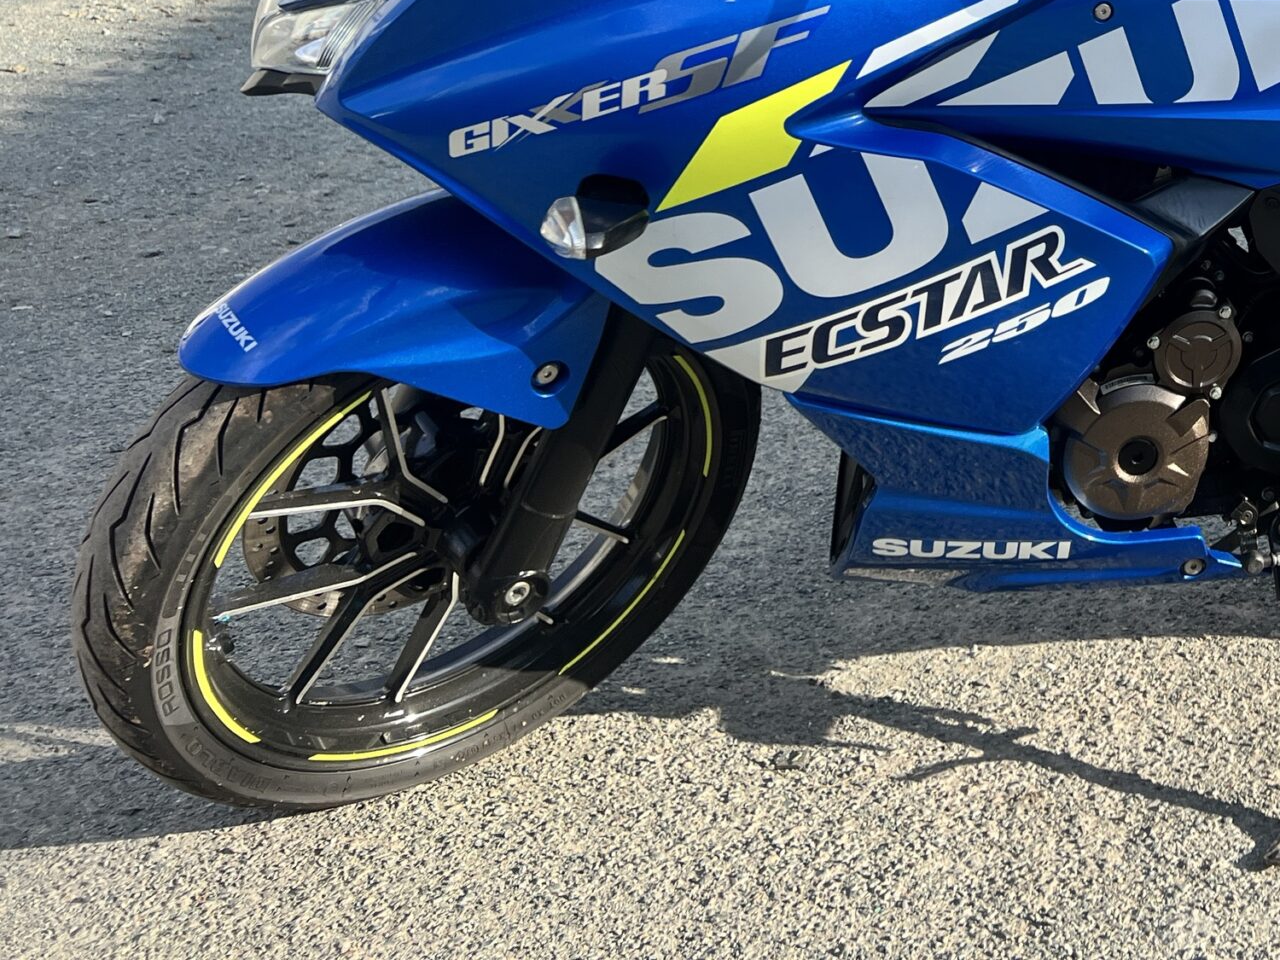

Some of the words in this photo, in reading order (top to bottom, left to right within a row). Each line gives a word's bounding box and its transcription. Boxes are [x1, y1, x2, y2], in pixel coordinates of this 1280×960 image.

[638, 4, 831, 114] SF
[215, 302, 258, 353] SUZUKI
[761, 225, 1096, 379] ECSTAR
[938, 276, 1111, 364] 250
[872, 538, 1072, 560] SUZUKI
[154, 628, 179, 717] ROSSO
